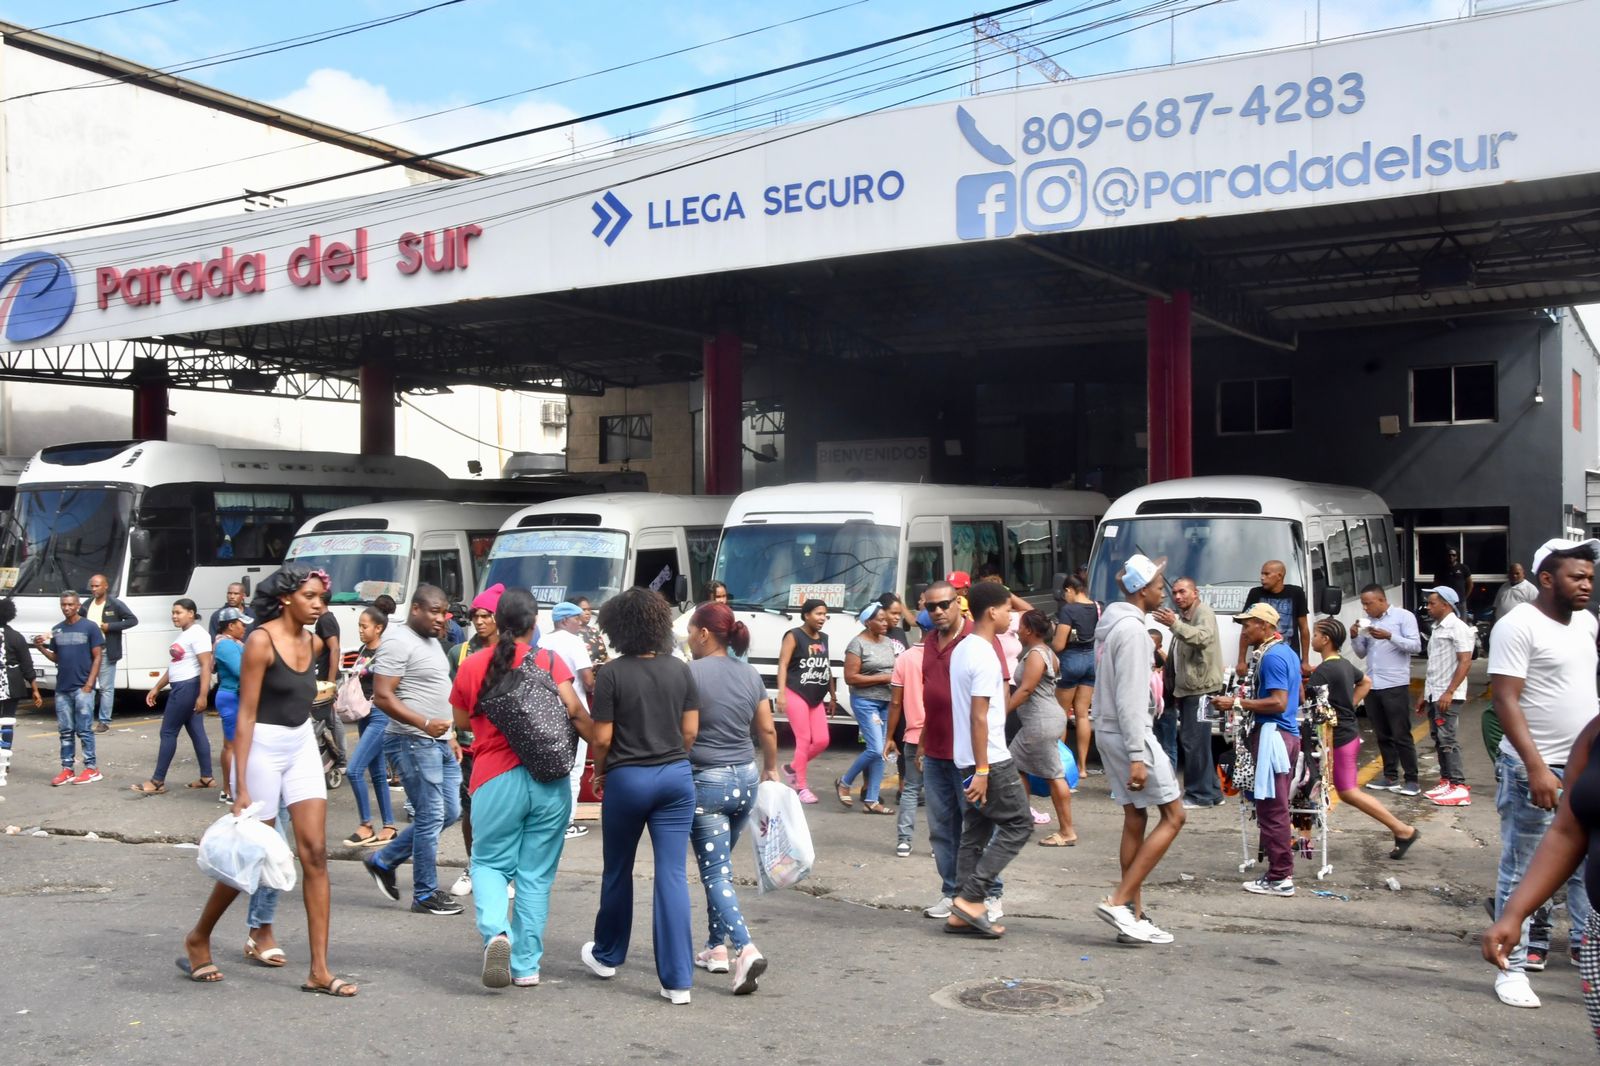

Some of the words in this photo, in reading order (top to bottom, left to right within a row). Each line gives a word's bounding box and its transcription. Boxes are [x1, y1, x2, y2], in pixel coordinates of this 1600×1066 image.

[1022, 71, 1366, 155] 809-687-4283
[1093, 130, 1517, 217] @Paradadelsur
[648, 191, 746, 229] LLEGA
[763, 170, 905, 216] SEGURO
[96, 246, 266, 309] Parada
[287, 228, 368, 288] del
[396, 224, 483, 275] sur
[818, 446, 929, 463] BIENVENIDOS
[794, 584, 842, 593] EXPRESO
[1212, 594, 1241, 609] JUAN
[799, 657, 830, 668] SQUA
